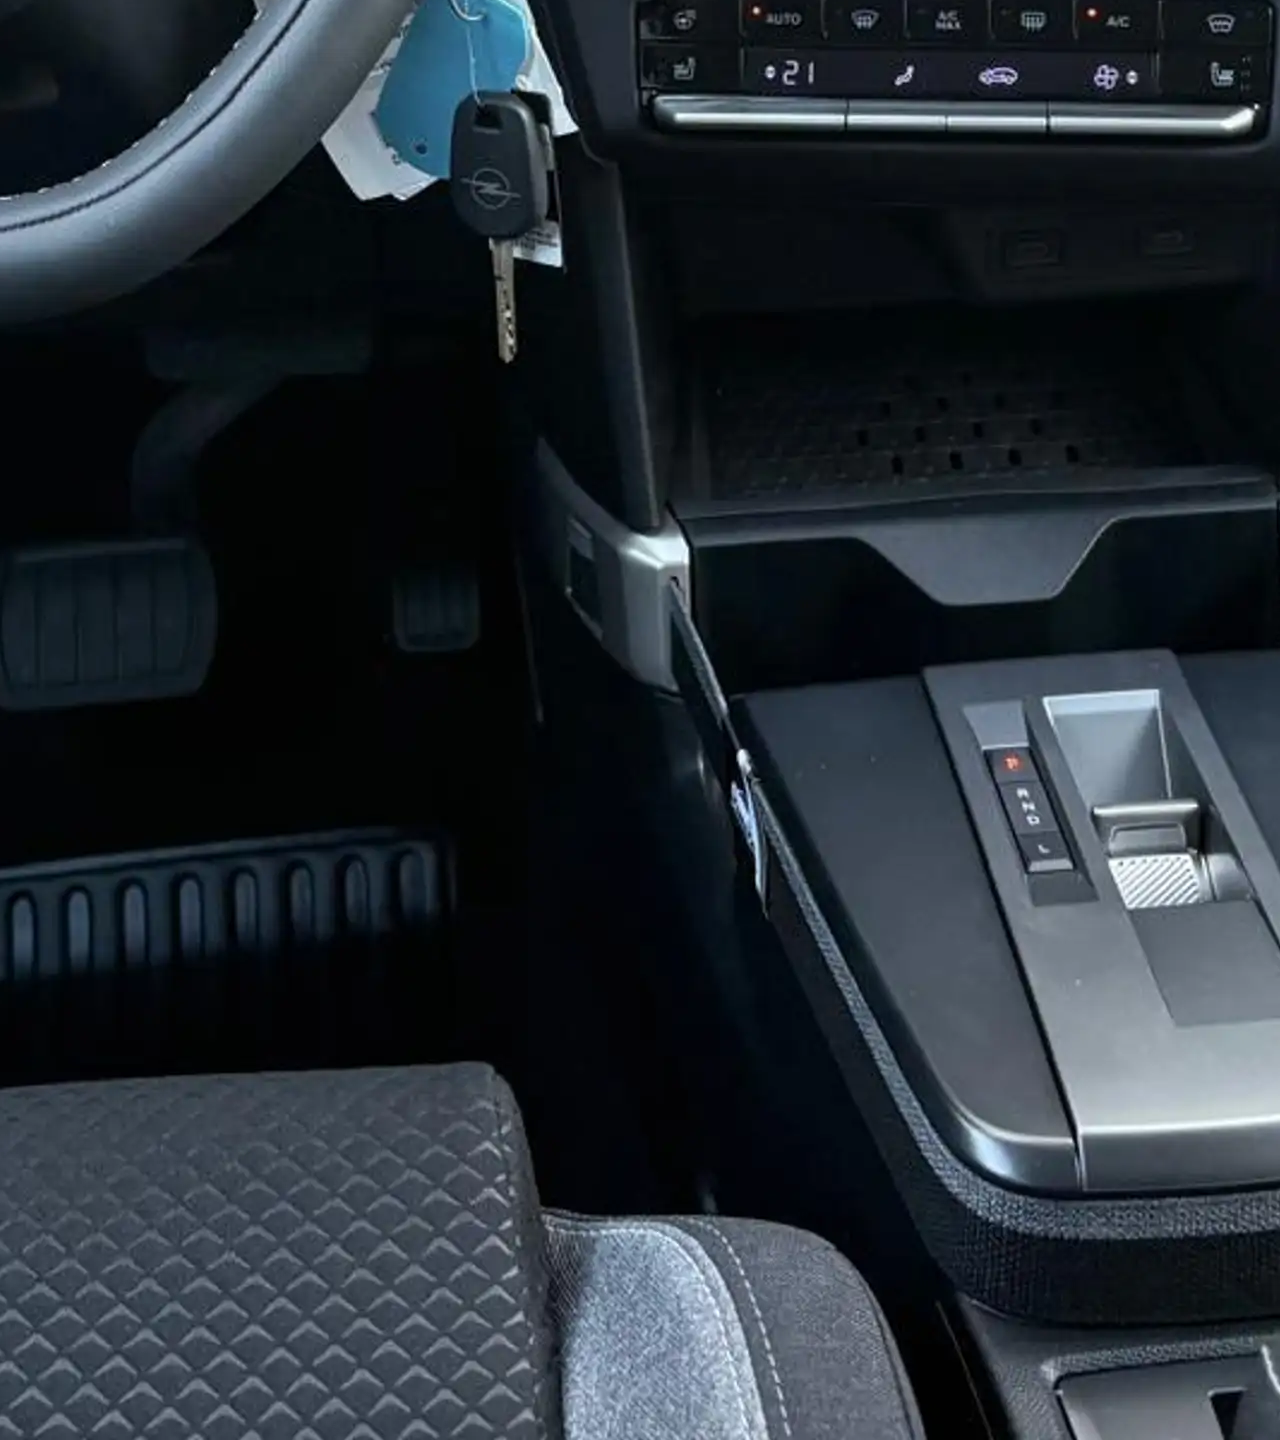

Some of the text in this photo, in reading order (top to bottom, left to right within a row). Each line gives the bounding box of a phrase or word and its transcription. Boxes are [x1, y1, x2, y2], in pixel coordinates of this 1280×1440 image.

[766, 12, 801, 26] AUTO
[938, 11, 957, 20] A/C
[1106, 15, 1130, 27] A/C
[782, 60, 815, 85] 21
